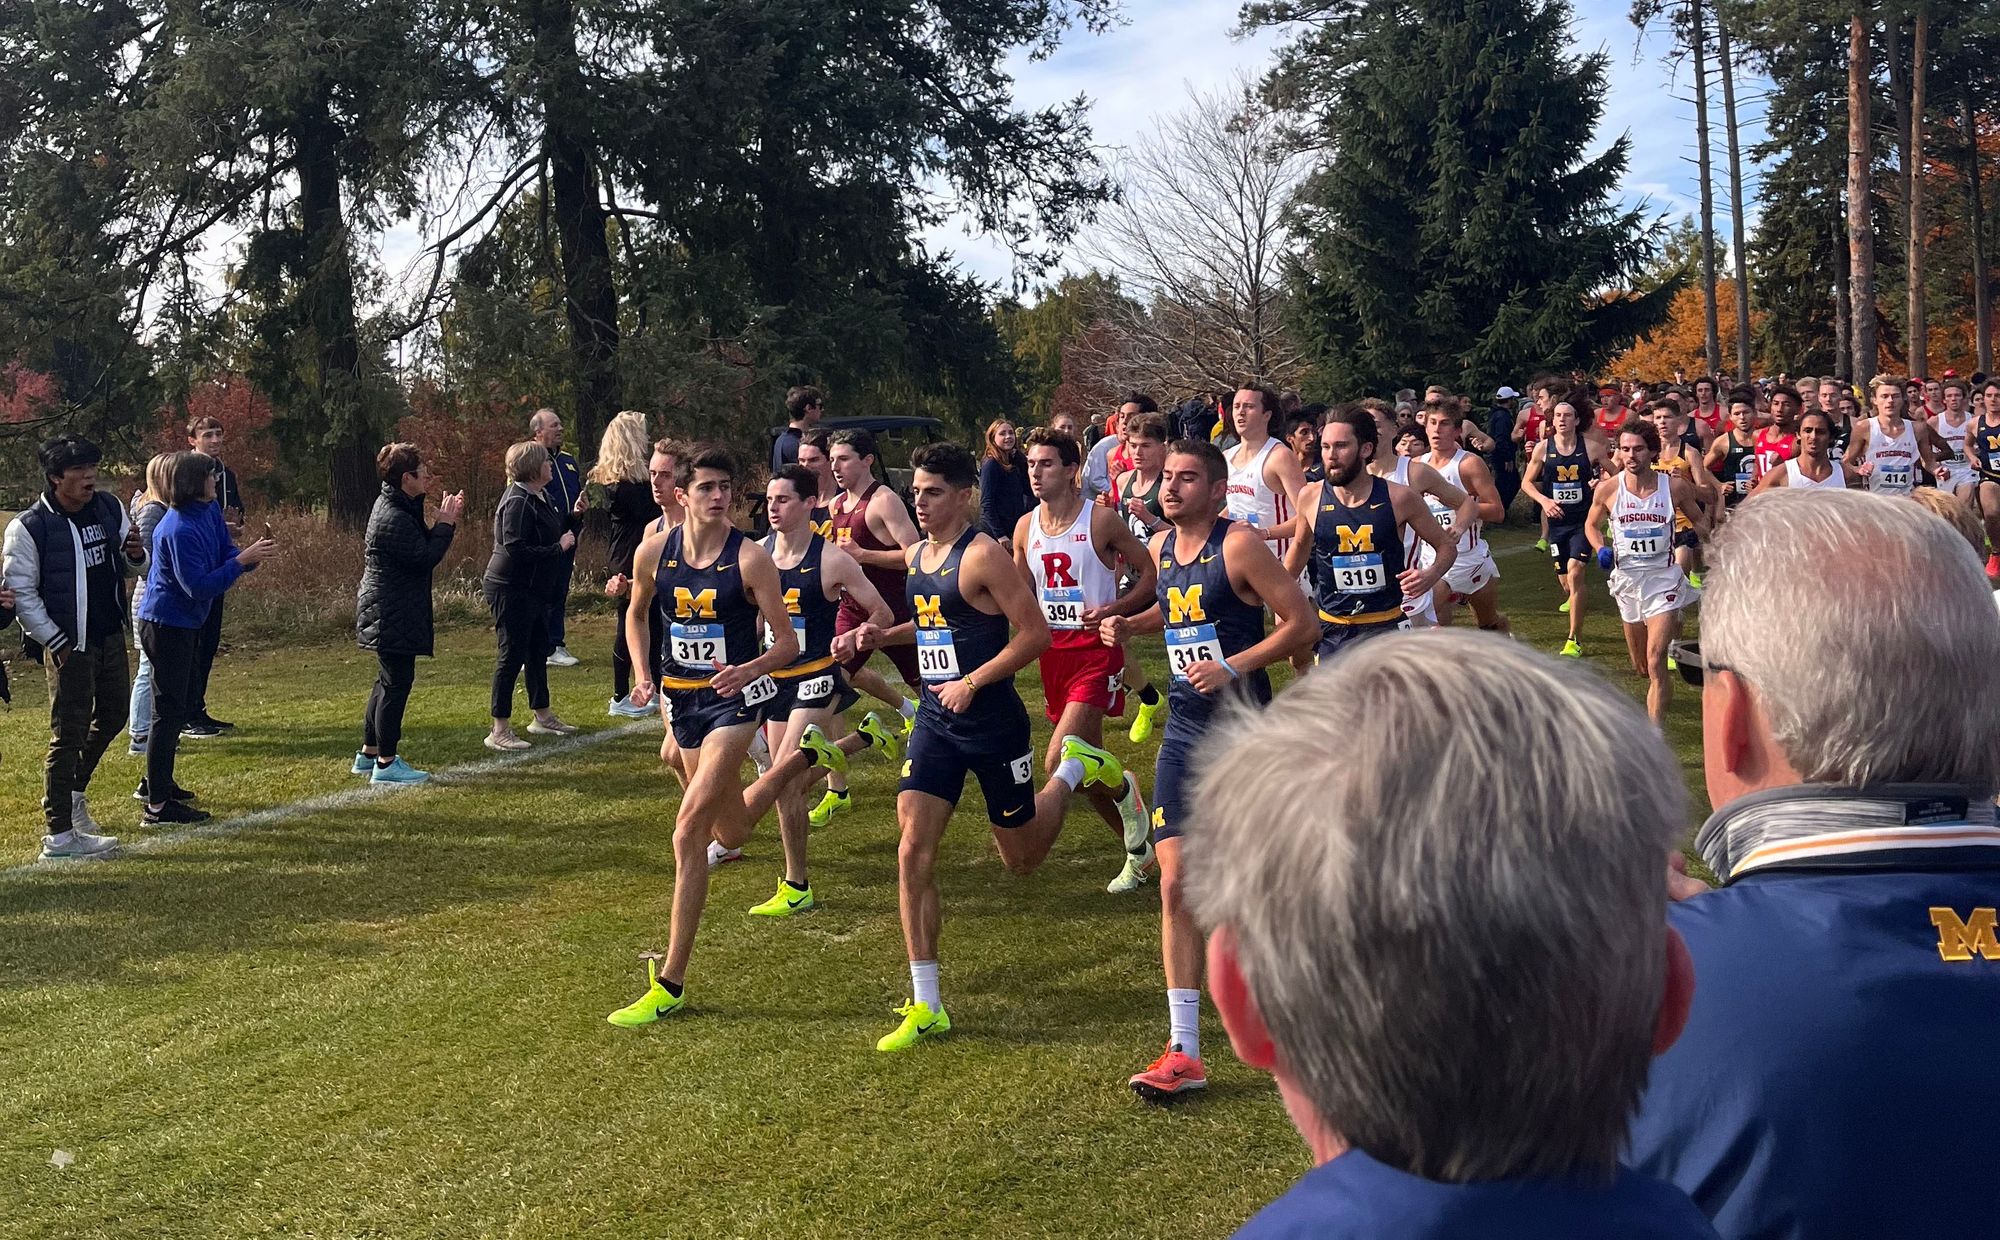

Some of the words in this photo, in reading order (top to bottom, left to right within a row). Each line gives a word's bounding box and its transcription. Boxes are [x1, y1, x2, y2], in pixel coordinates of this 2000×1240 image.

[1556, 465, 1579, 481] M
[1885, 474, 1907, 483] 414
[1226, 484, 1255, 497] SCONSIN
[1741, 482, 1746, 490] 3
[1558, 491, 1578, 500] 325
[1436, 513, 1451, 525] 05
[1618, 513, 1667, 524] WISCONSIN
[1336, 524, 1375, 553] M
[1631, 539, 1656, 552] 411
[1041, 552, 1078, 588] R
[1342, 569, 1377, 586] 319
[674, 587, 717, 619] M
[914, 595, 947, 627] M
[1167, 584, 1206, 623] M
[1048, 605, 1077, 621] 394
[678, 642, 716, 661] 312
[921, 649, 949, 670] 310
[1175, 646, 1213, 670] 316
[750, 677, 776, 700] 312
[804, 681, 829, 696] 308
[1929, 907, 2000, 961] M
